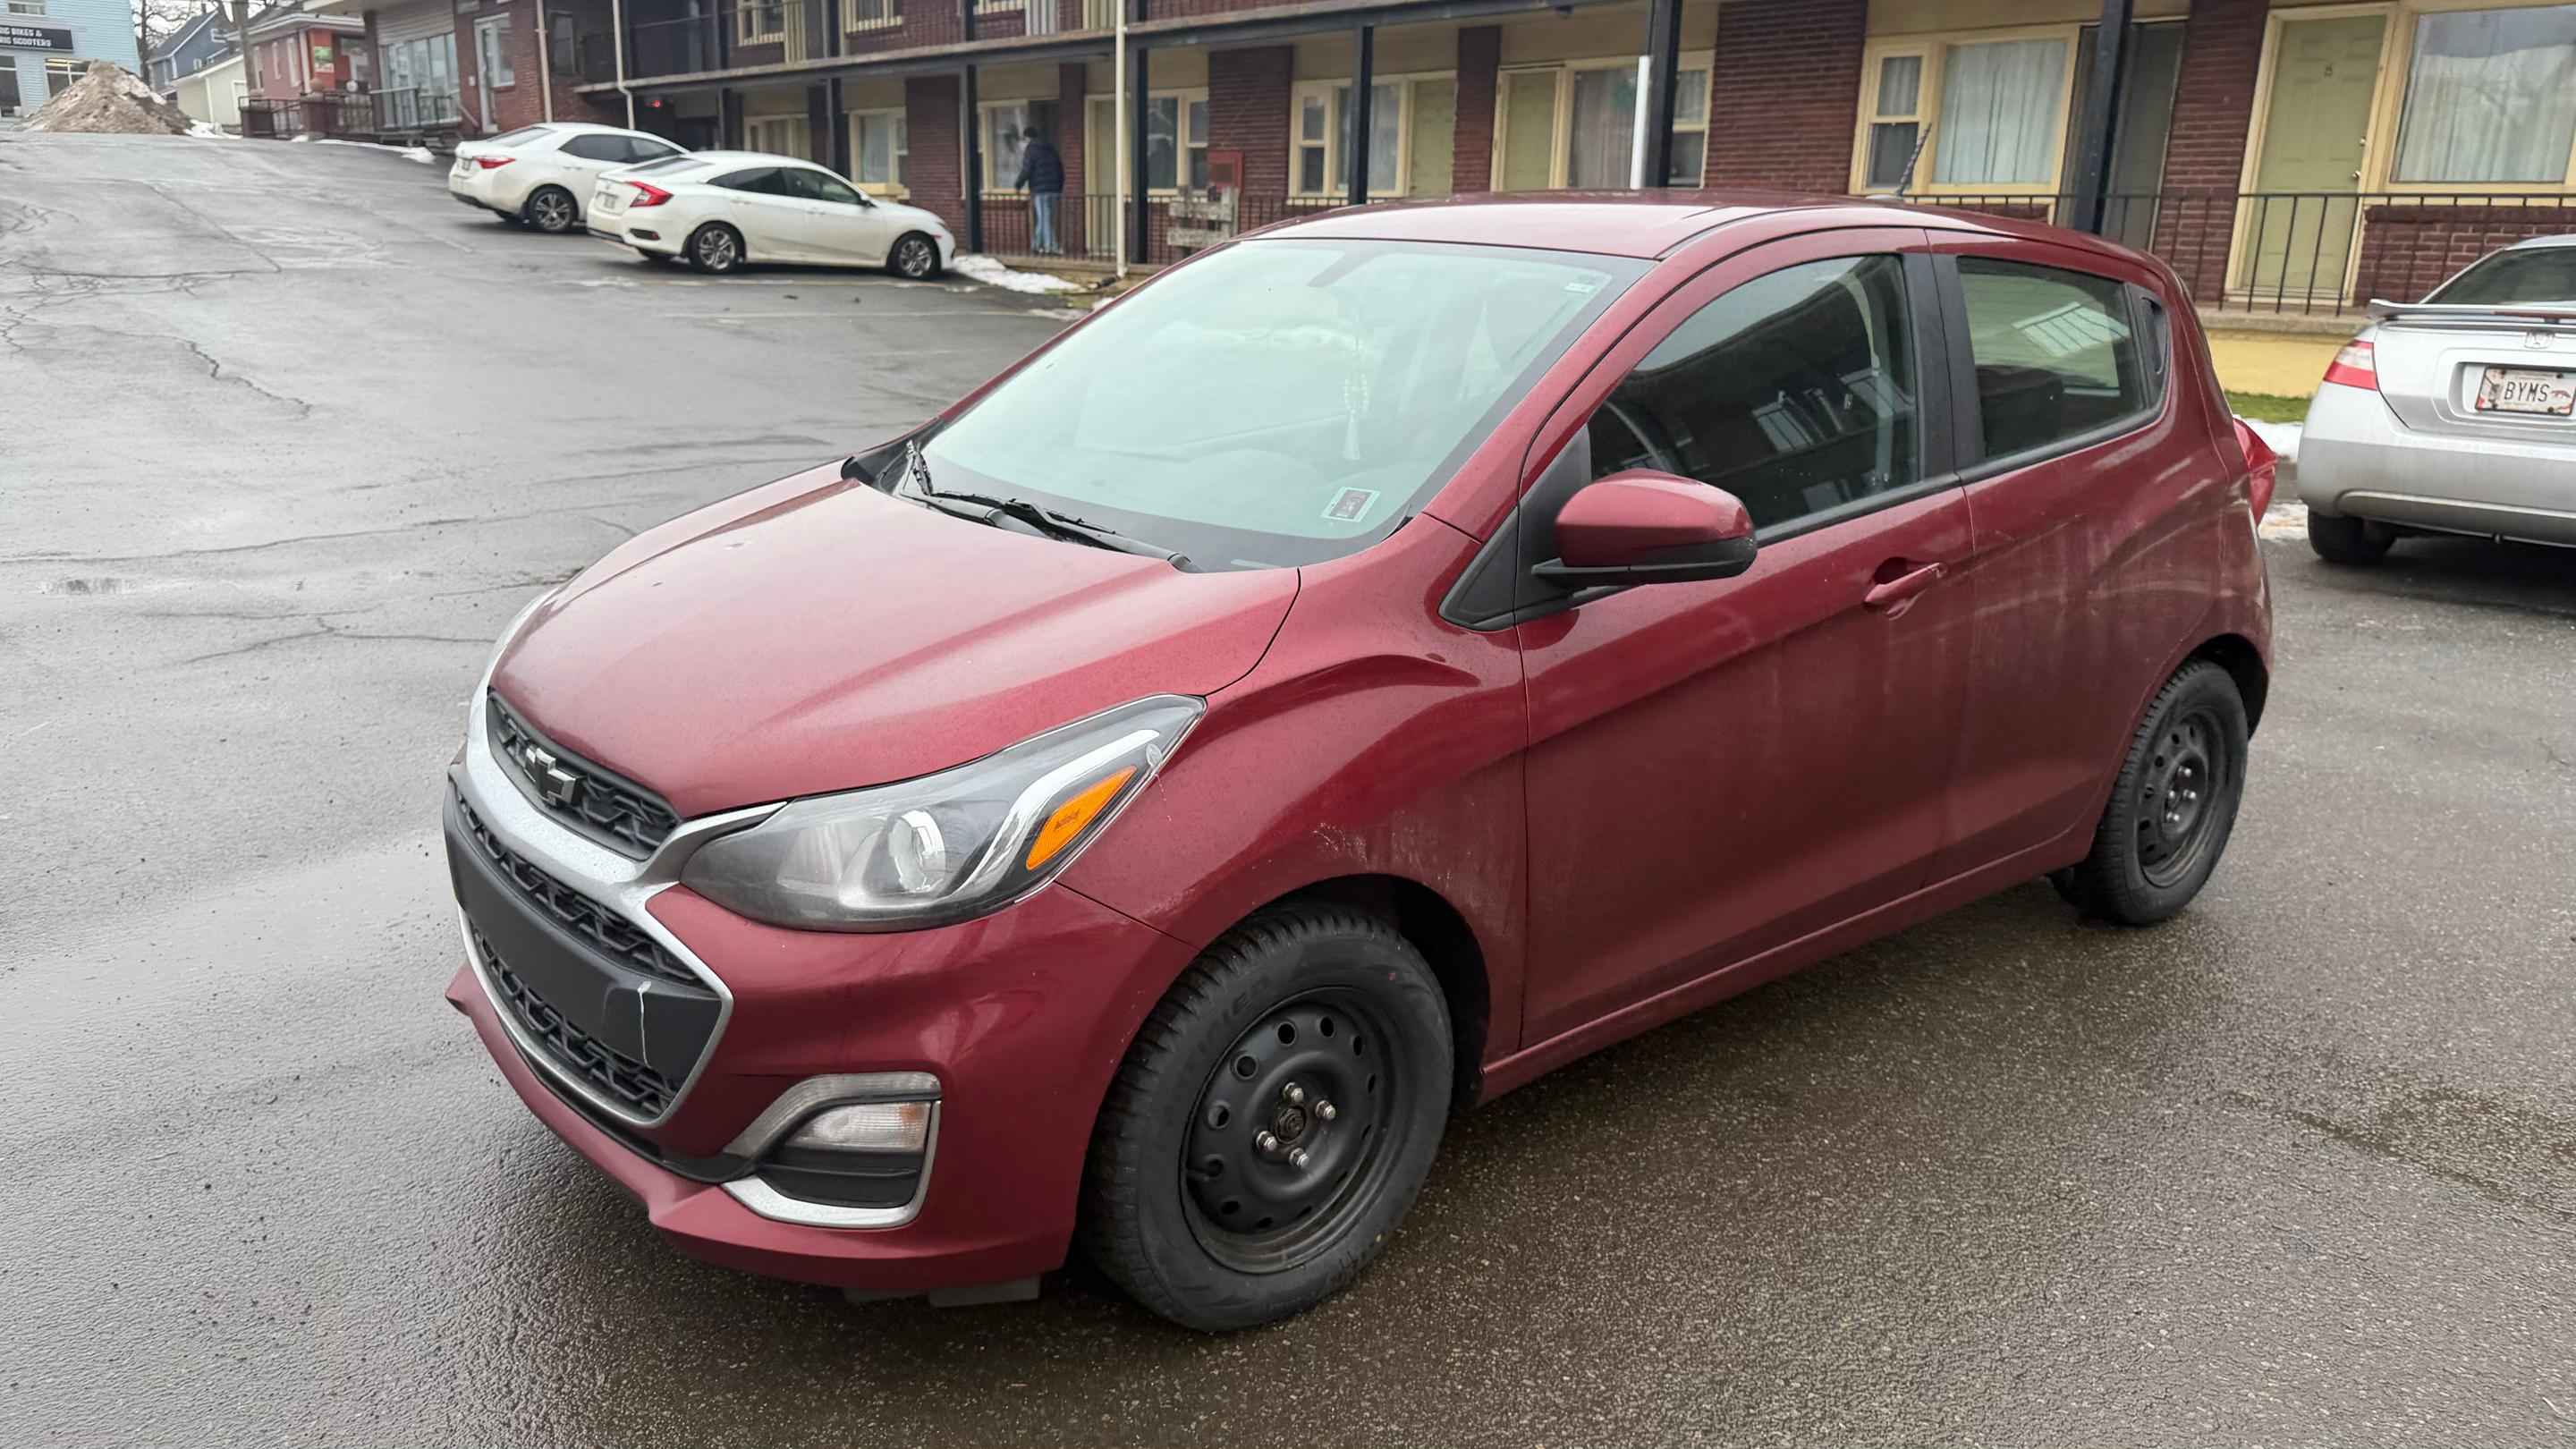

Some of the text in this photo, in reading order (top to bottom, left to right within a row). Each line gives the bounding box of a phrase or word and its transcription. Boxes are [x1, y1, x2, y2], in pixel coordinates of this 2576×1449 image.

[11, 28, 34, 37] BIKES
[13, 38, 51, 47] SCOOTERS
[2504, 381, 2551, 402] BYMS
